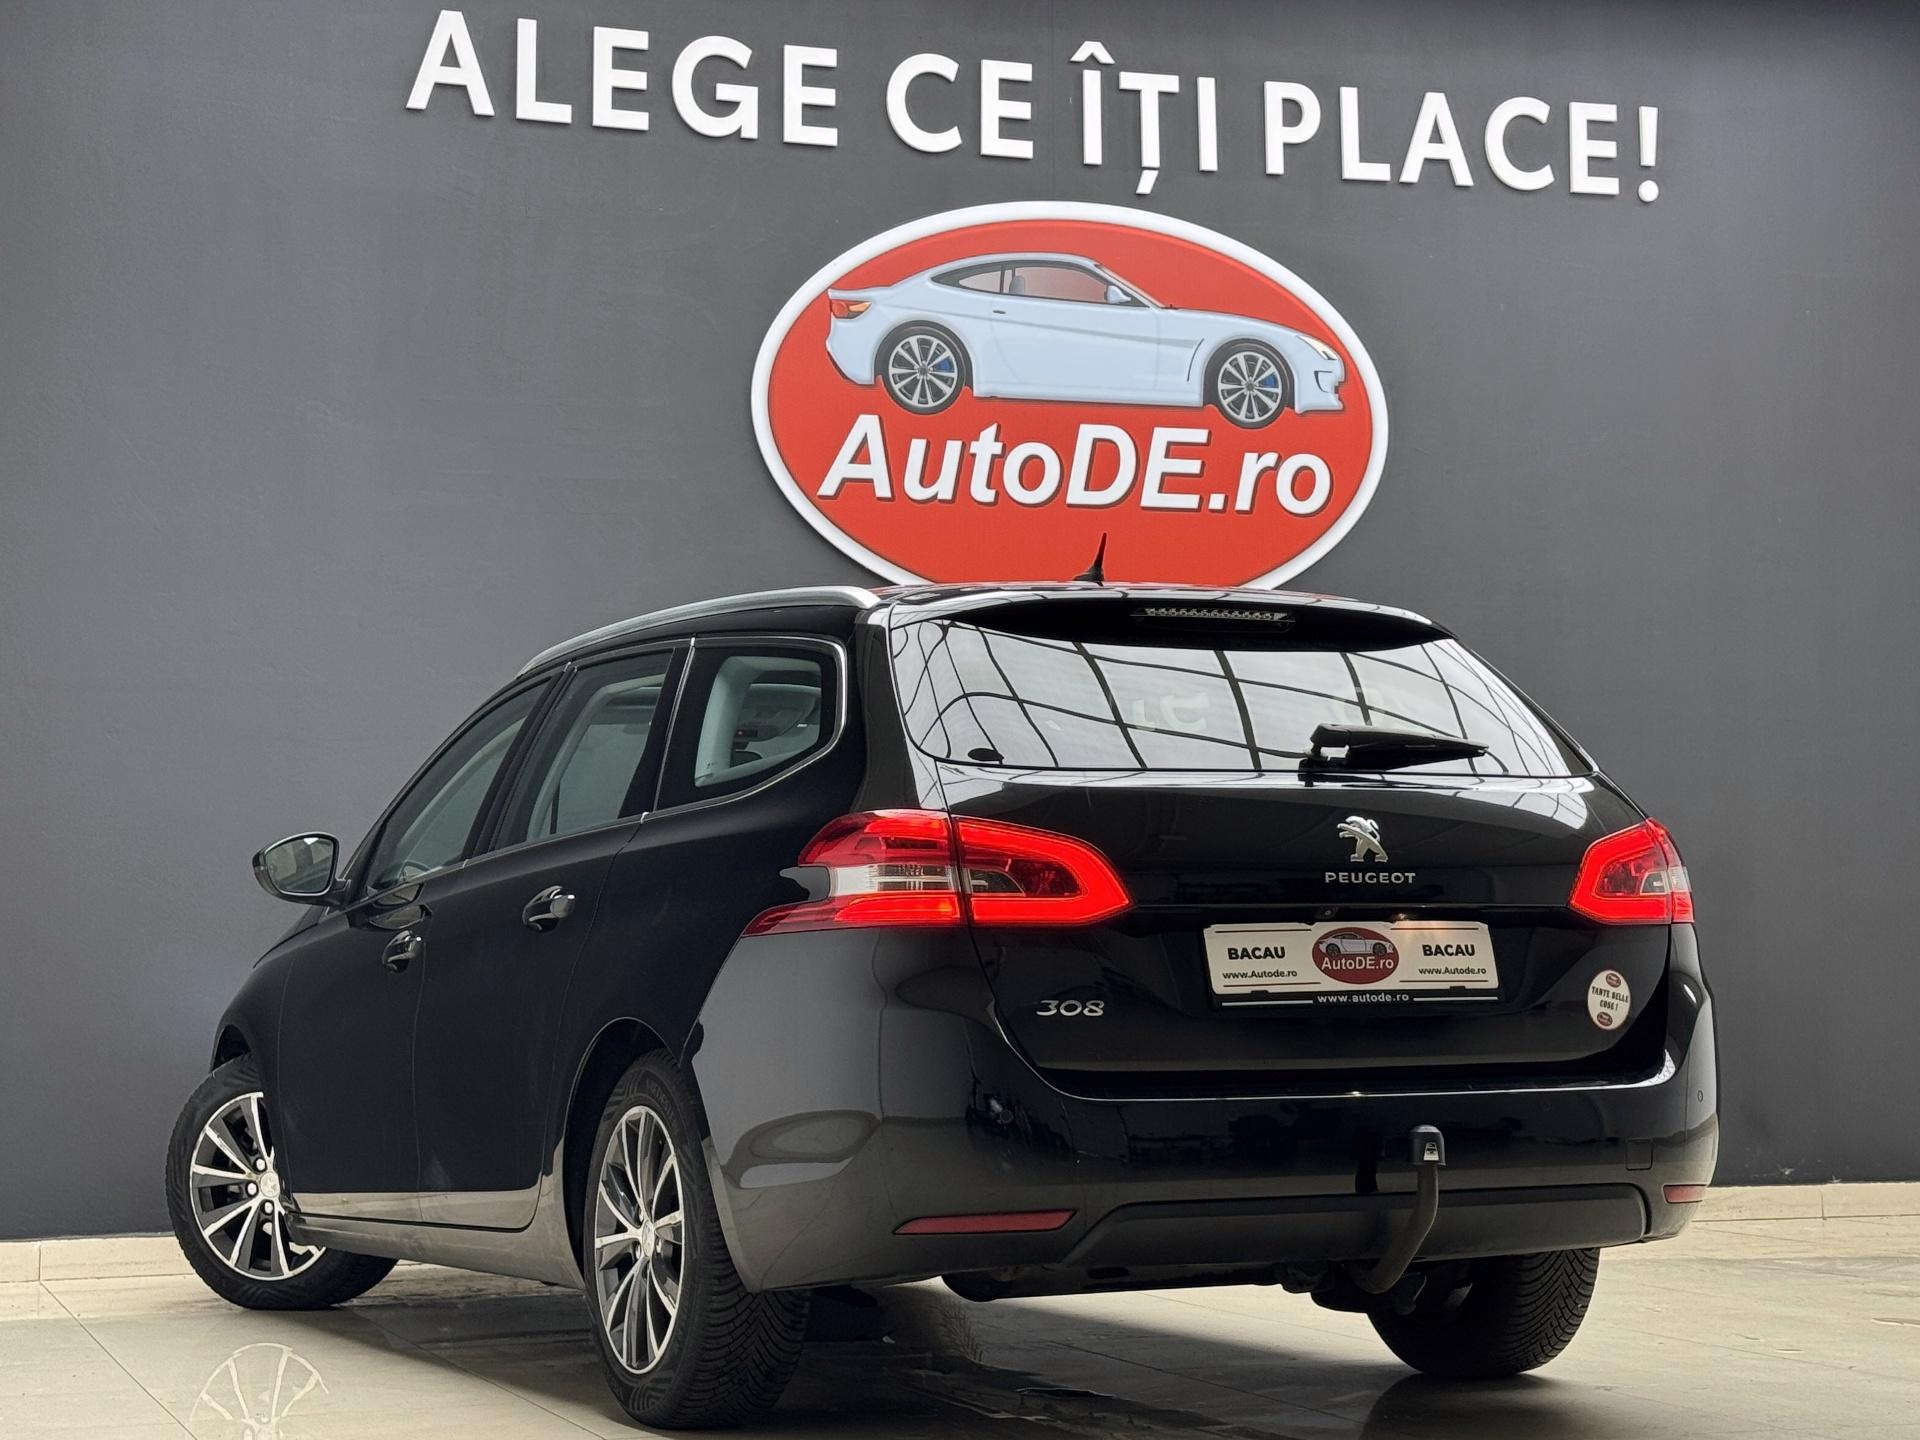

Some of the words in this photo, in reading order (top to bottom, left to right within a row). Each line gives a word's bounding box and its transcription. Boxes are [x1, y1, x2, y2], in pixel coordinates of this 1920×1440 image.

[405, 9, 839, 147] ALEGE
[885, 53, 1034, 160] CE
[1263, 80, 1660, 203] PLACE!
[816, 414, 1333, 516] AutoDE.ro
[1324, 871, 1417, 884] PEUGEOT
[1227, 946, 1287, 960] BACAU
[1421, 943, 1476, 957] BACAU
[1321, 955, 1395, 971] AutoDE.ro
[1222, 968, 1298, 979] www.Autode.ro
[1418, 965, 1487, 976] www.Autode.ro
[1317, 992, 1410, 1003] www.autode.ro
[1592, 986, 1610, 998] TANTE
[1612, 991, 1629, 1003] BELLE
[1036, 999, 1105, 1017] 308
